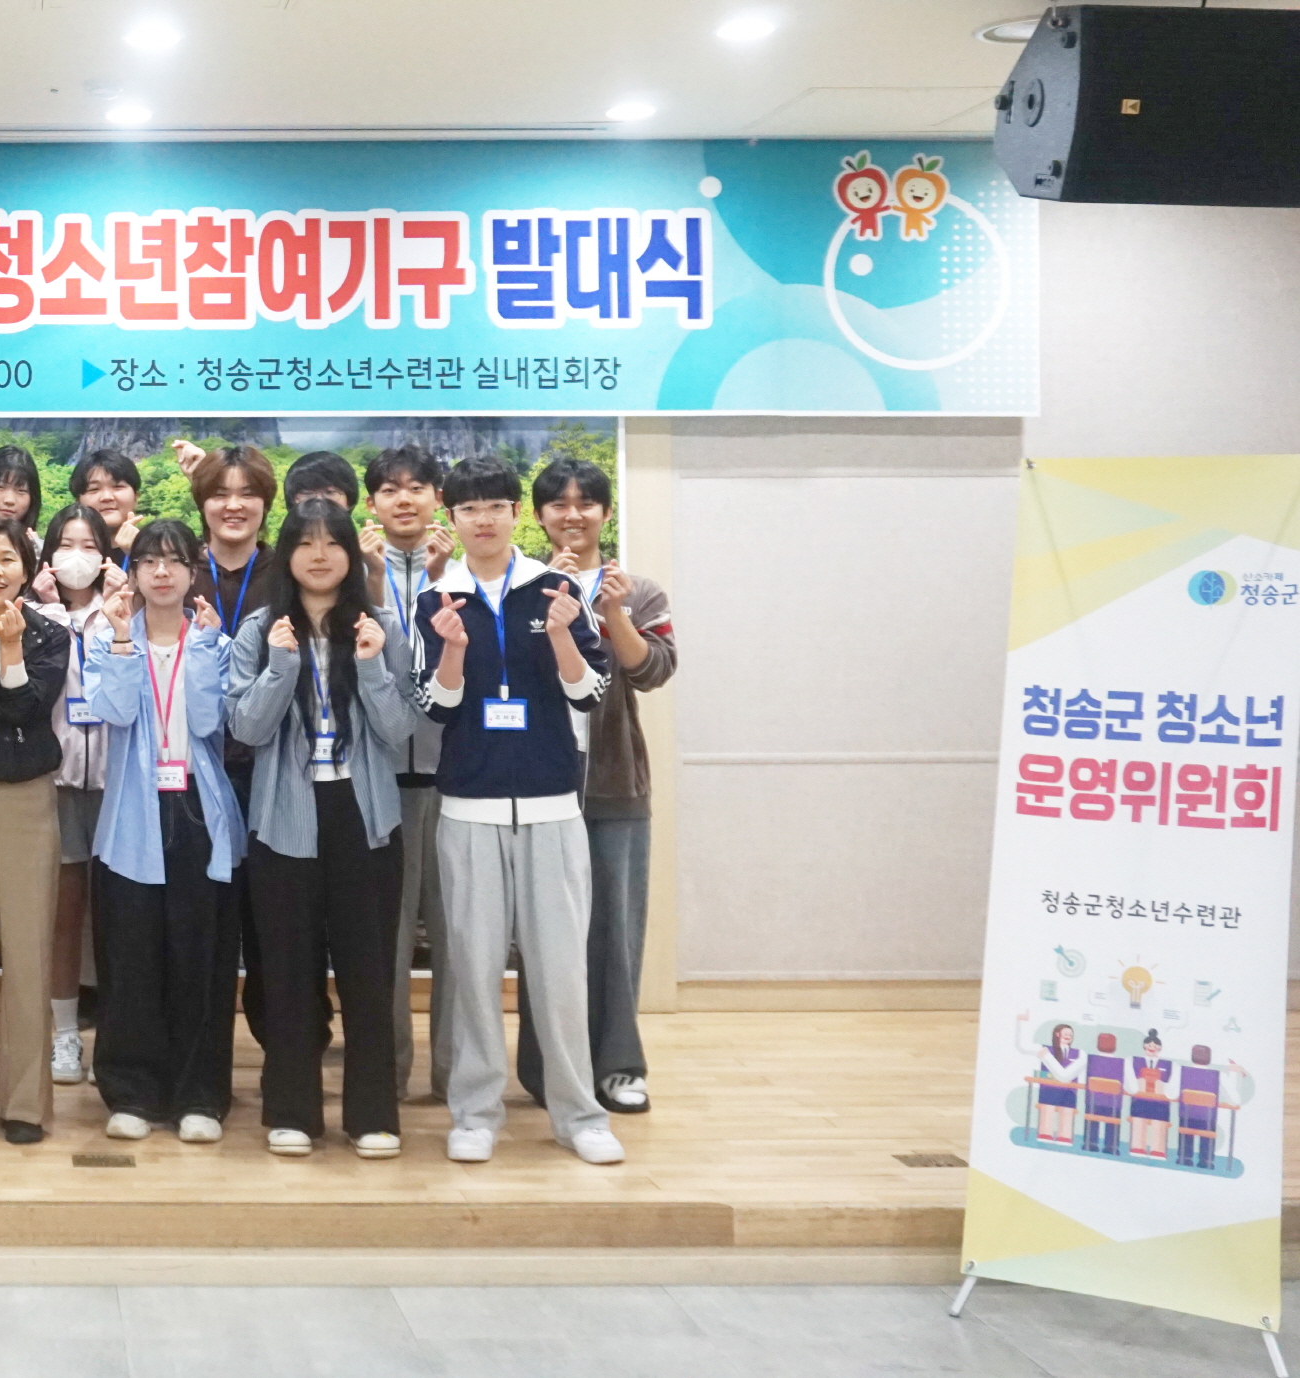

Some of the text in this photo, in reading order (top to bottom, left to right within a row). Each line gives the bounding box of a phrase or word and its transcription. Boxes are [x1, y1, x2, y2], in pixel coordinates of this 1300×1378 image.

[492, 217, 704, 320] 발대식
[110, 357, 169, 392] 장소
[196, 356, 466, 392] 청송군청소년수련관
[472, 355, 622, 391] 실내집회장
[1240, 584, 1299, 606] 청송군
[1023, 684, 1284, 747] 청송군 청소년
[1015, 753, 1282, 832] 운영위원회
[1041, 889, 1242, 930] 청송군청소년수련관
